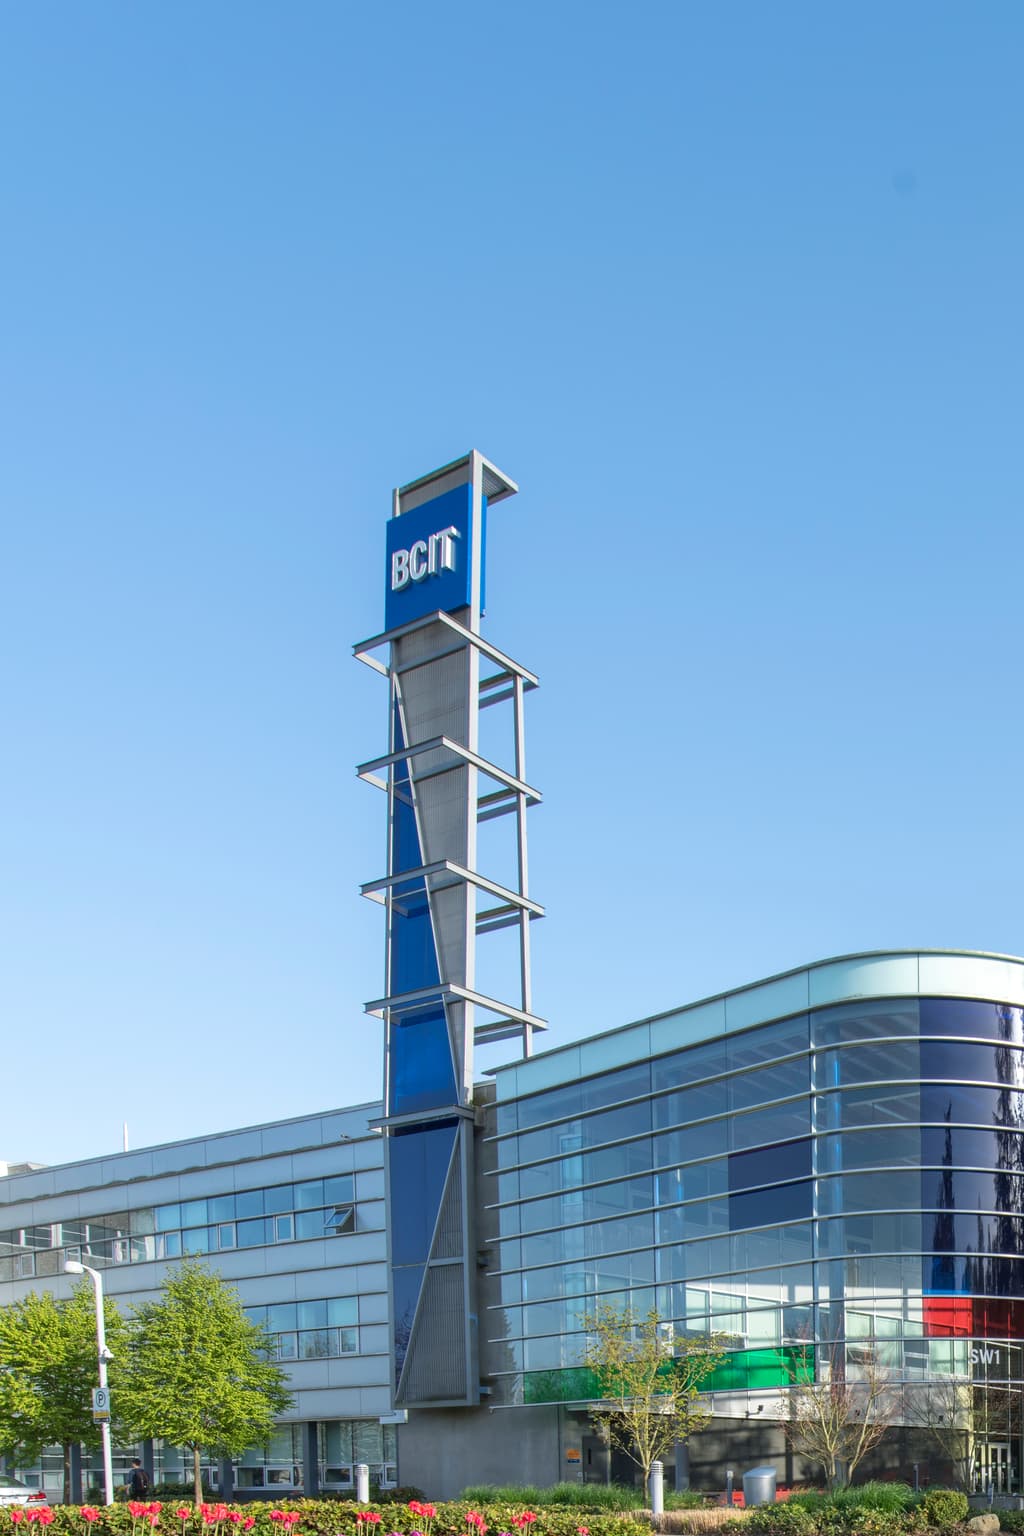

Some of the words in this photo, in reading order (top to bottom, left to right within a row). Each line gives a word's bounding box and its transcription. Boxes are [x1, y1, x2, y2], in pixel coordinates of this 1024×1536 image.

[392, 525, 461, 591] BCIT
[970, 1348, 1000, 1365] SW1
[98, 1393, 104, 1404] P
